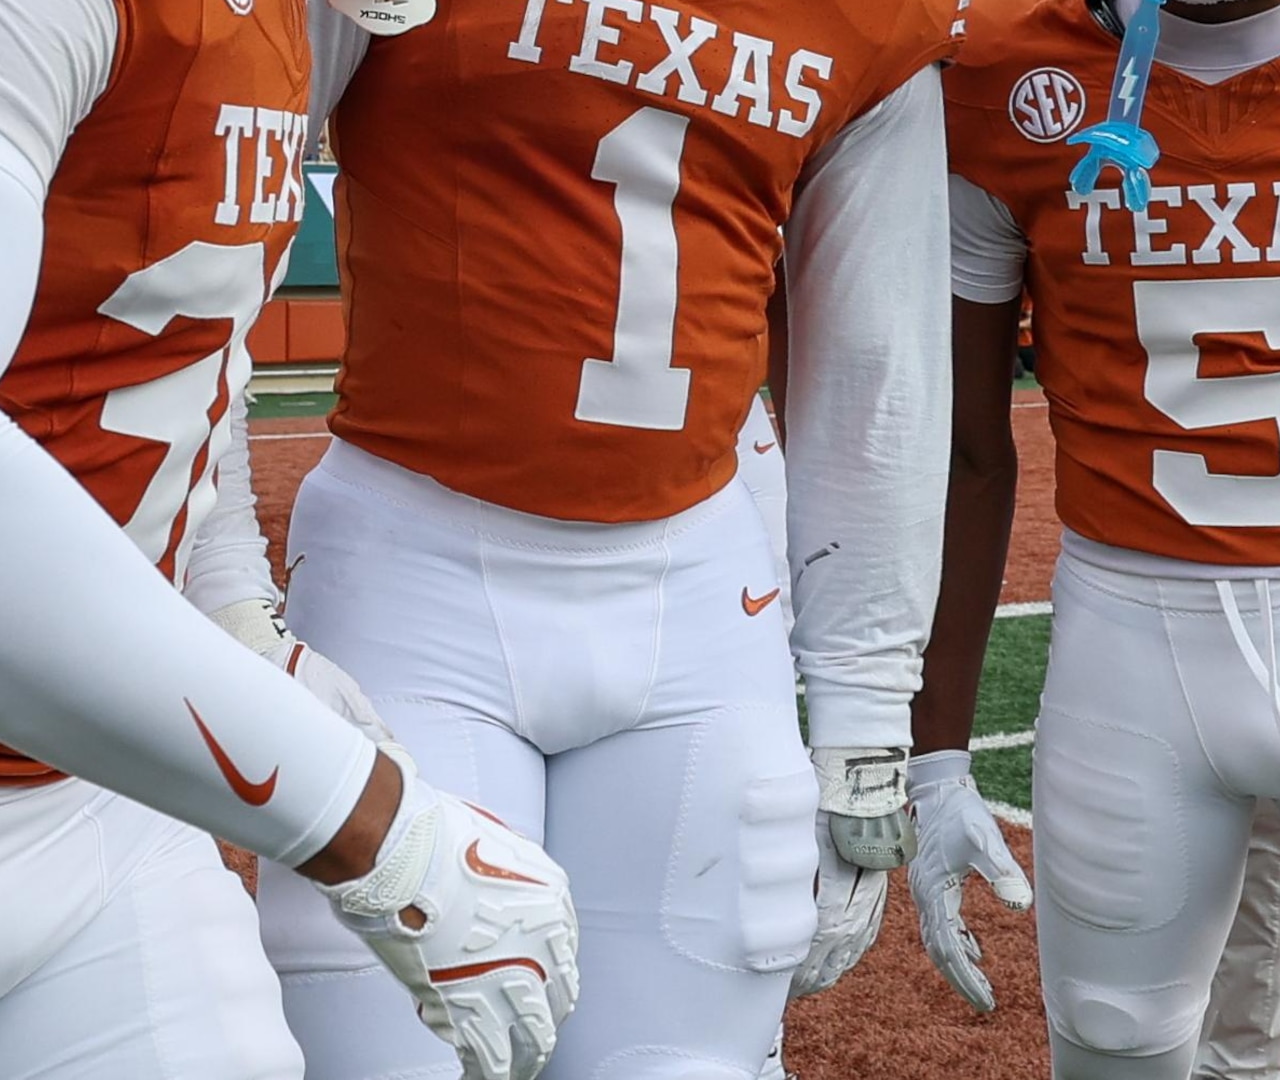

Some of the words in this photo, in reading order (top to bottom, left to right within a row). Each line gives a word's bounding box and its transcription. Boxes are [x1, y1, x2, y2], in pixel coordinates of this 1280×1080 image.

[360, 9, 406, 24] SHOCK
[1015, 72, 1083, 139] SEC
[575, 105, 692, 430] 1
